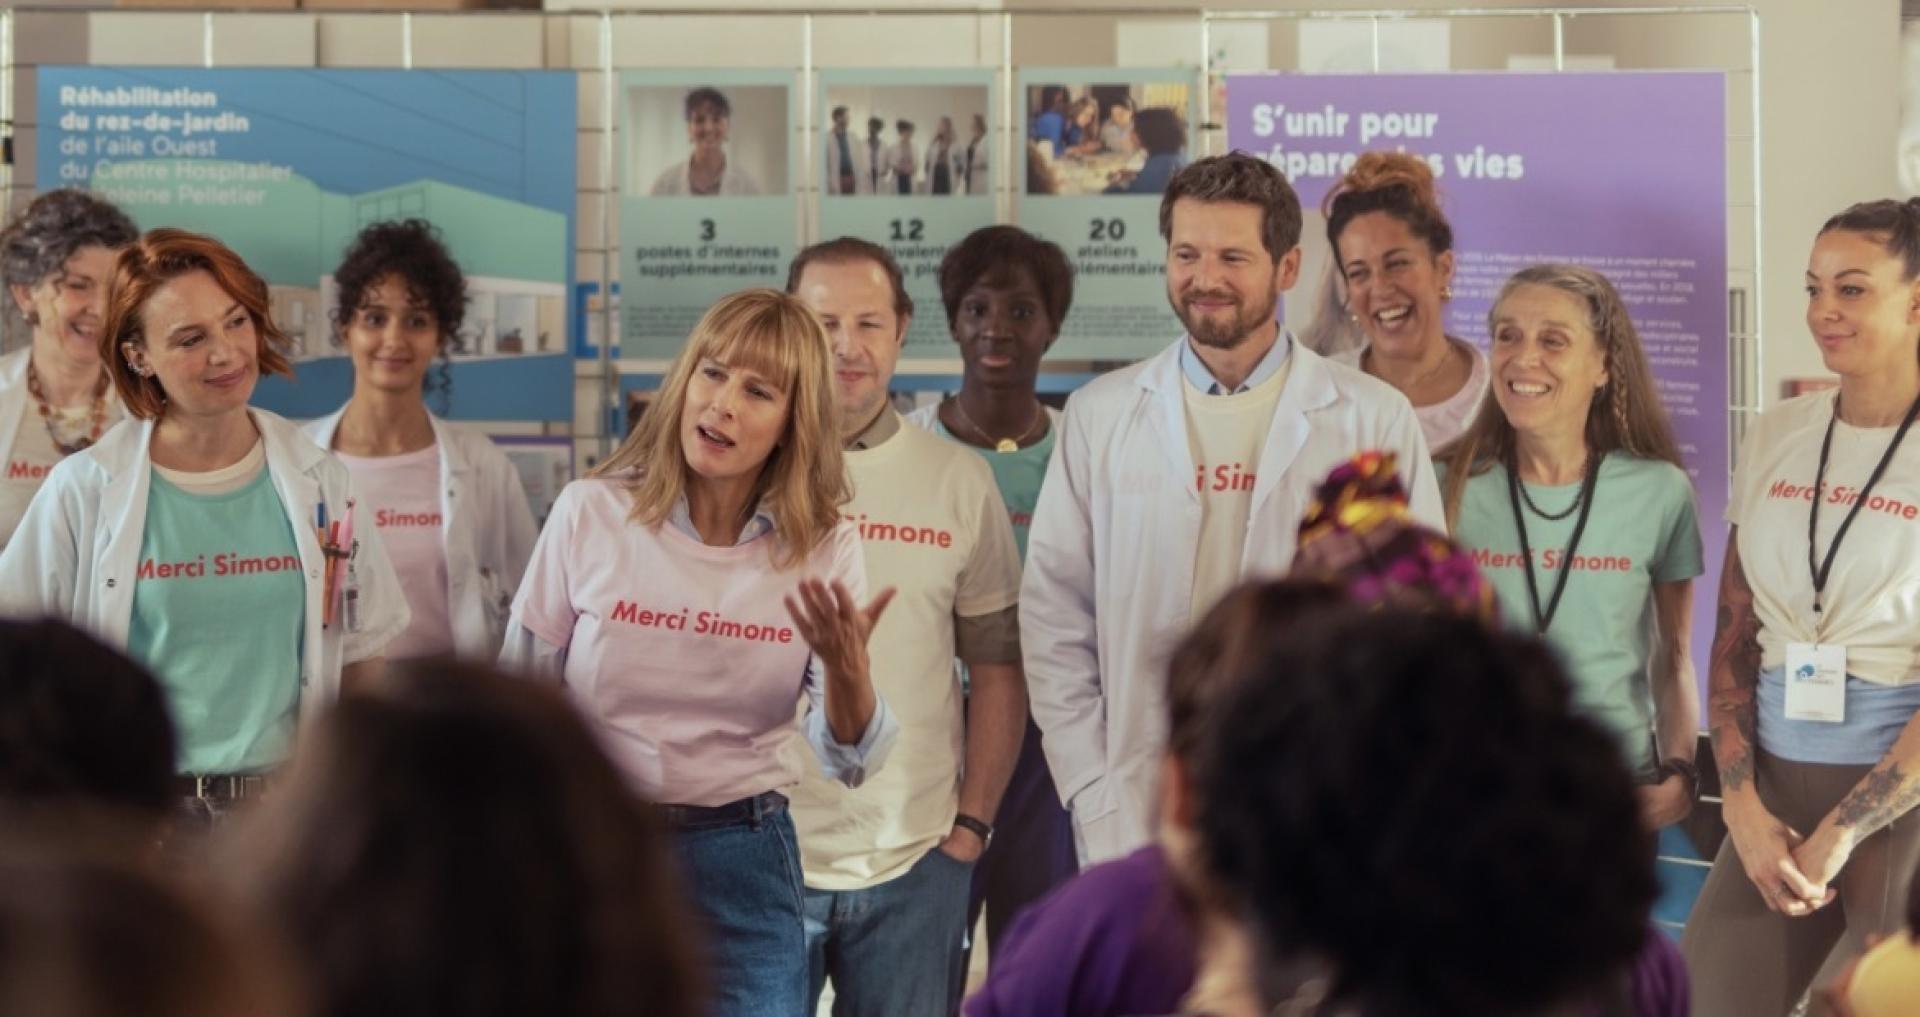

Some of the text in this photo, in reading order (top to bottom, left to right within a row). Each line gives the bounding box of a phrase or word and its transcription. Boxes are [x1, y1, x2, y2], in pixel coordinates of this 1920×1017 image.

[60, 86, 217, 107] Réhabilitation
[60, 111, 249, 136] du rez-de-jardin
[1252, 103, 1439, 144] S'unir pour
[60, 137, 88, 155] de
[152, 136, 217, 155] Ouest
[60, 159, 292, 182] du Centre Hospitalier
[1455, 145, 1524, 179] vies
[178, 184, 266, 204] Pelletier
[700, 219, 716, 241] 3
[891, 219, 925, 241] 12
[1090, 218, 1126, 241] 20
[637, 246, 692, 261] postes
[1078, 244, 1138, 258] ateliers
[639, 261, 778, 277] supplémentaires
[375, 509, 442, 527] Simon
[845, 513, 953, 549] imone
[137, 551, 303, 580] Merci Simon
[611, 599, 793, 644] Merci Simone
